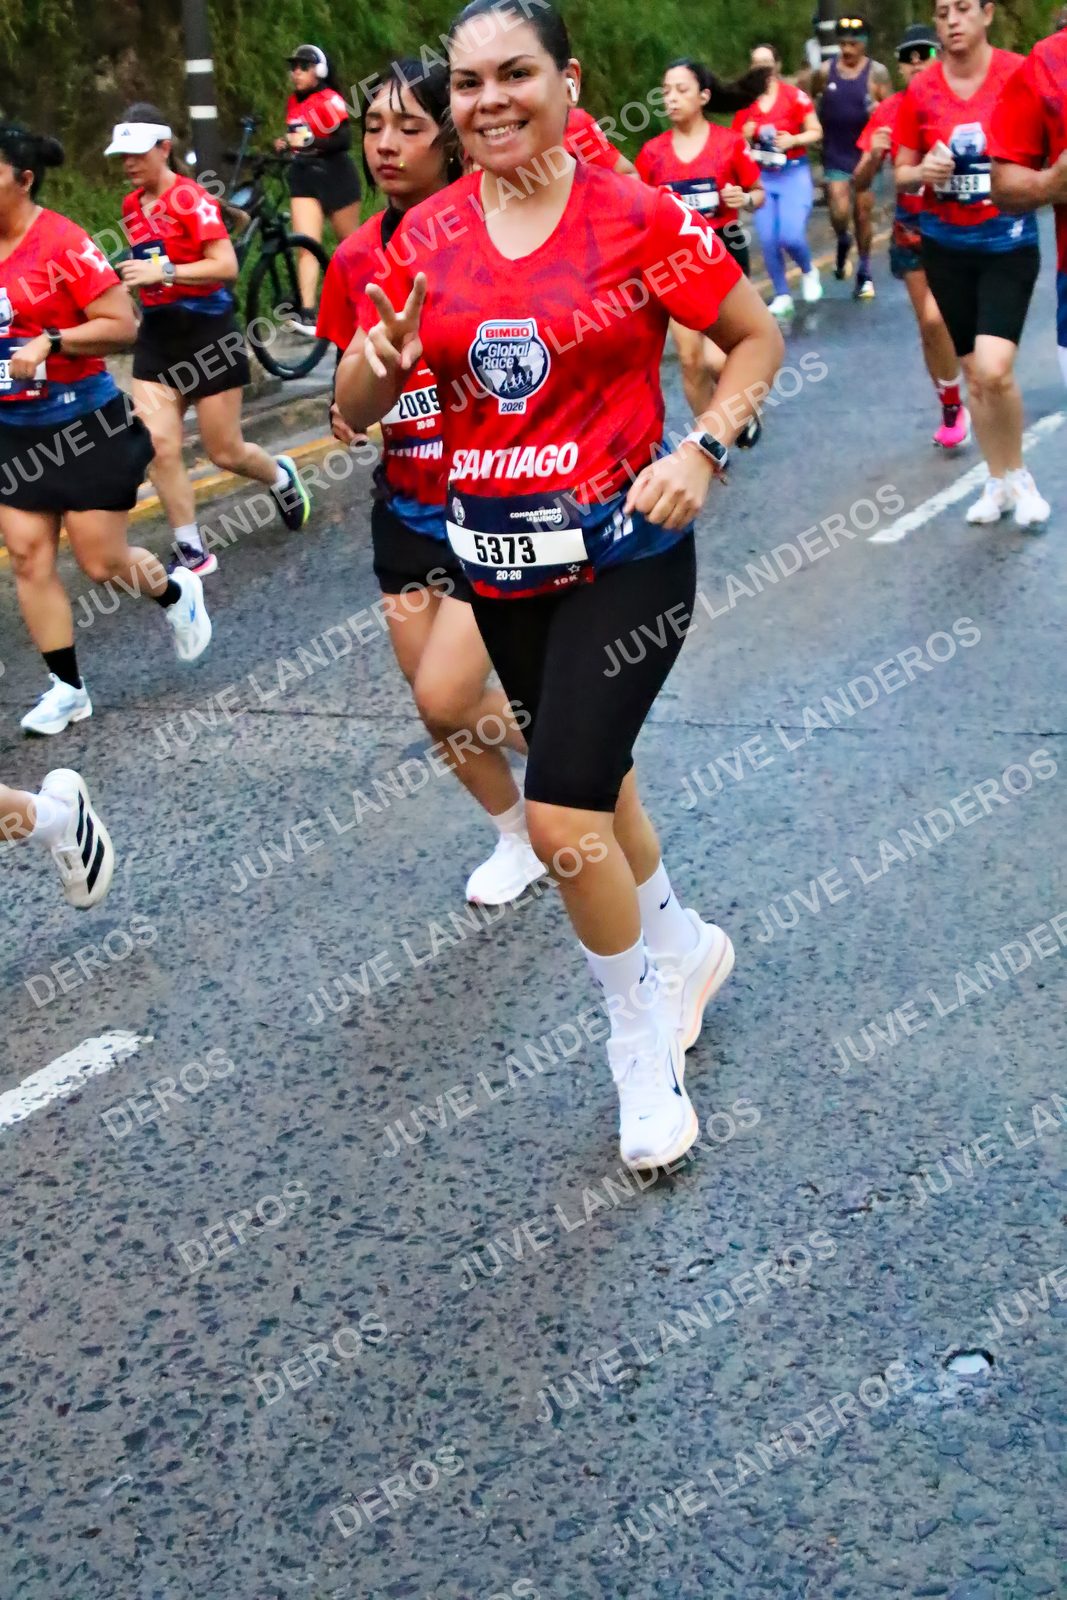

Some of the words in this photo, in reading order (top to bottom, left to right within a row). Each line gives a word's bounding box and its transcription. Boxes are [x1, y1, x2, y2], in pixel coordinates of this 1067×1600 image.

[485, 327, 530, 339] BIMBO
[488, 342, 530, 358] Global
[482, 356, 515, 370] Race
[399, 387, 441, 420] 2089
[500, 401, 525, 412] 2026
[449, 441, 579, 481] SANTIAGO
[473, 533, 537, 565] 5373
[554, 574, 578, 586] 10K
